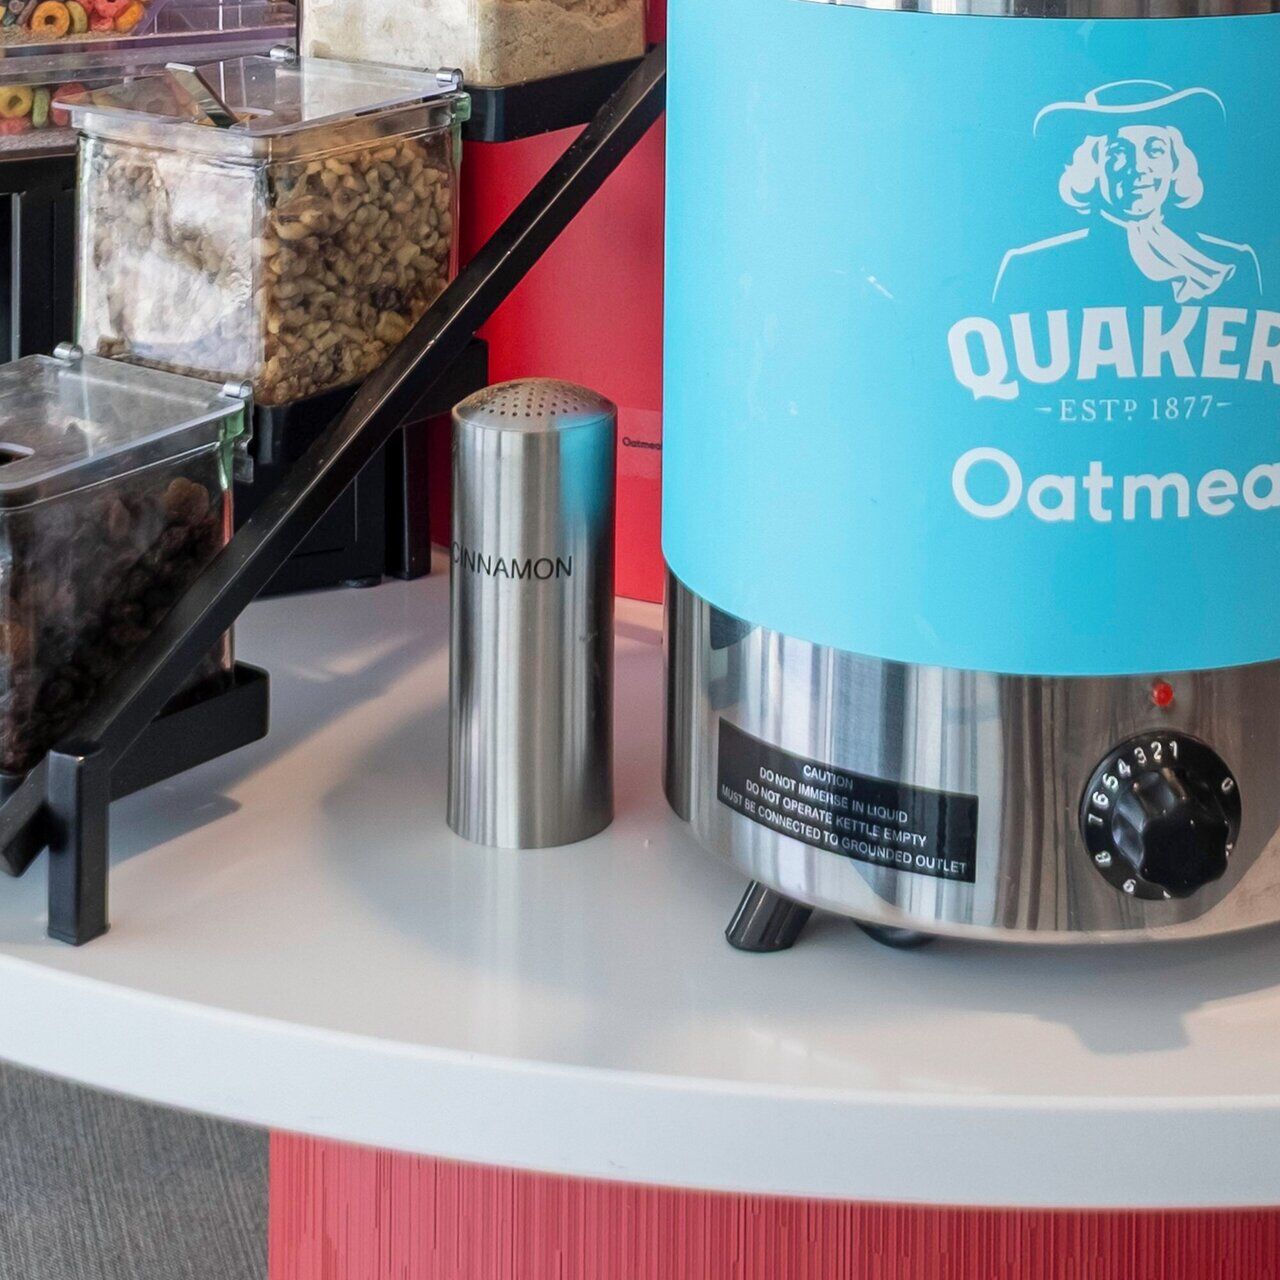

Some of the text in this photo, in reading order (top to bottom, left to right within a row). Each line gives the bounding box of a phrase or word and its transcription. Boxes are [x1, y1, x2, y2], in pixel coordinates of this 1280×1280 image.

[452, 540, 572, 580] CINNAMON
[1133, 746, 1147, 766] 3
[1150, 740, 1163, 762] 2
[1170, 740, 1179, 760] 1
[803, 764, 854, 791] CAUTION
[1117, 757, 1132, 778] 4
[1102, 772, 1119, 793] 5
[759, 766, 908, 823] DO NOT IMMERSE IN LIQUID
[1092, 791, 1109, 810] 6
[746, 778, 927, 848] DO NOT OPERATE KETTLE EMPTY
[1088, 813, 1103, 827] 7
[721, 783, 967, 874] MUST BE CONNECTED TO GROUNDED OUTLET
[1094, 850, 1112, 867] 8
